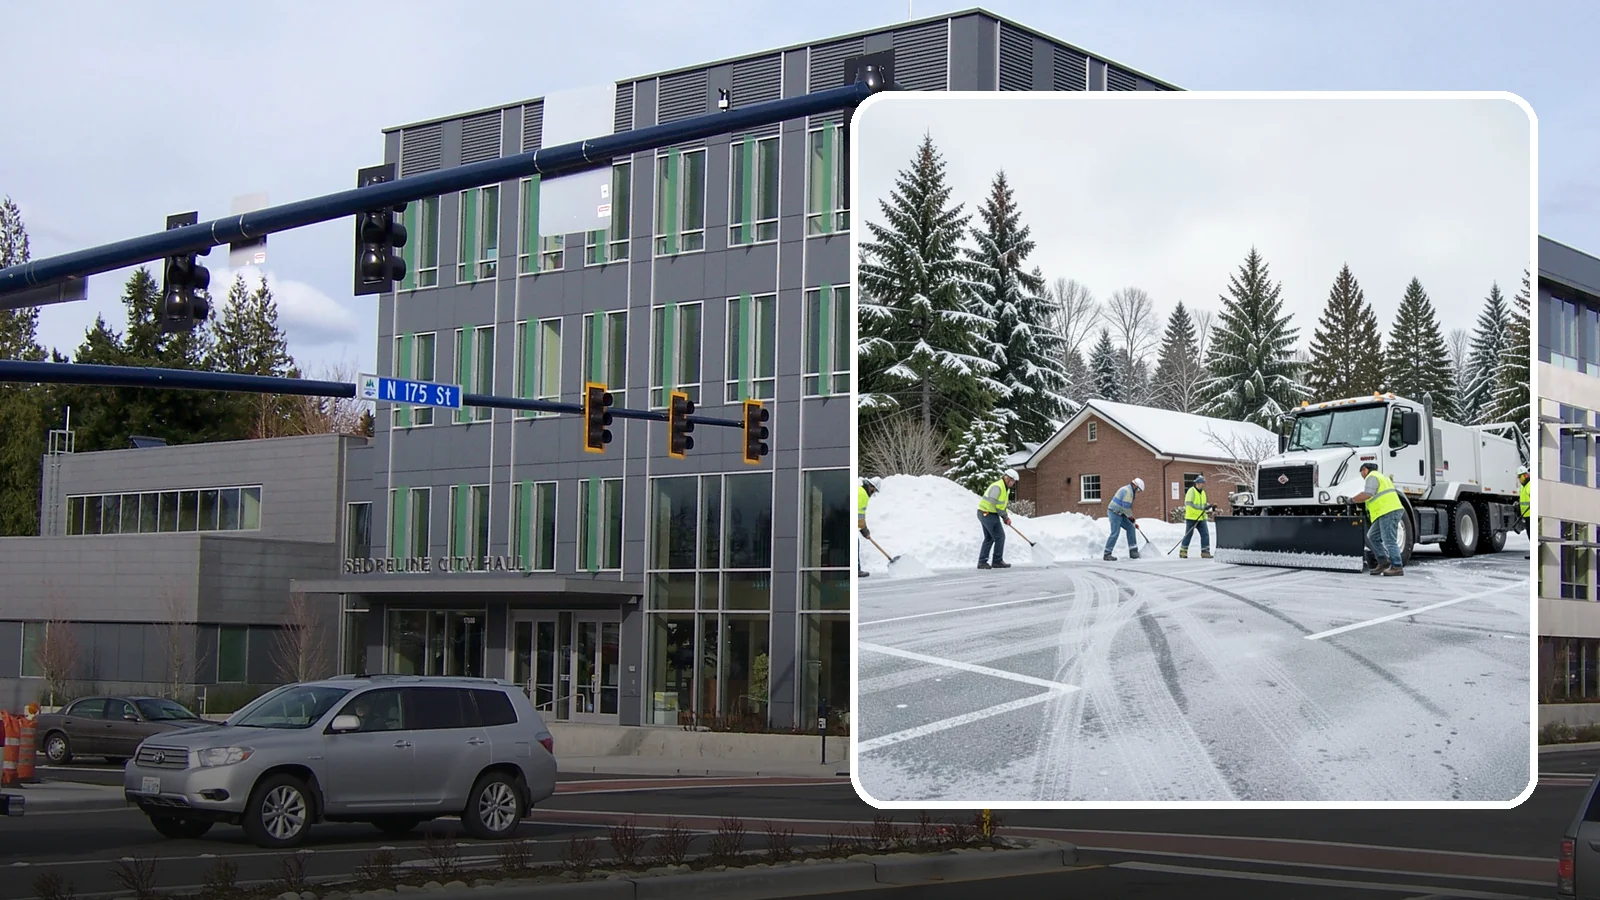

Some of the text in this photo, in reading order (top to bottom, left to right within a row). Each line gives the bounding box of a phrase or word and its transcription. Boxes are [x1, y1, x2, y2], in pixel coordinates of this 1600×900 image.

[387, 380, 451, 406] N 175 St
[344, 556, 525, 573] SHORELINE CITY HALL
